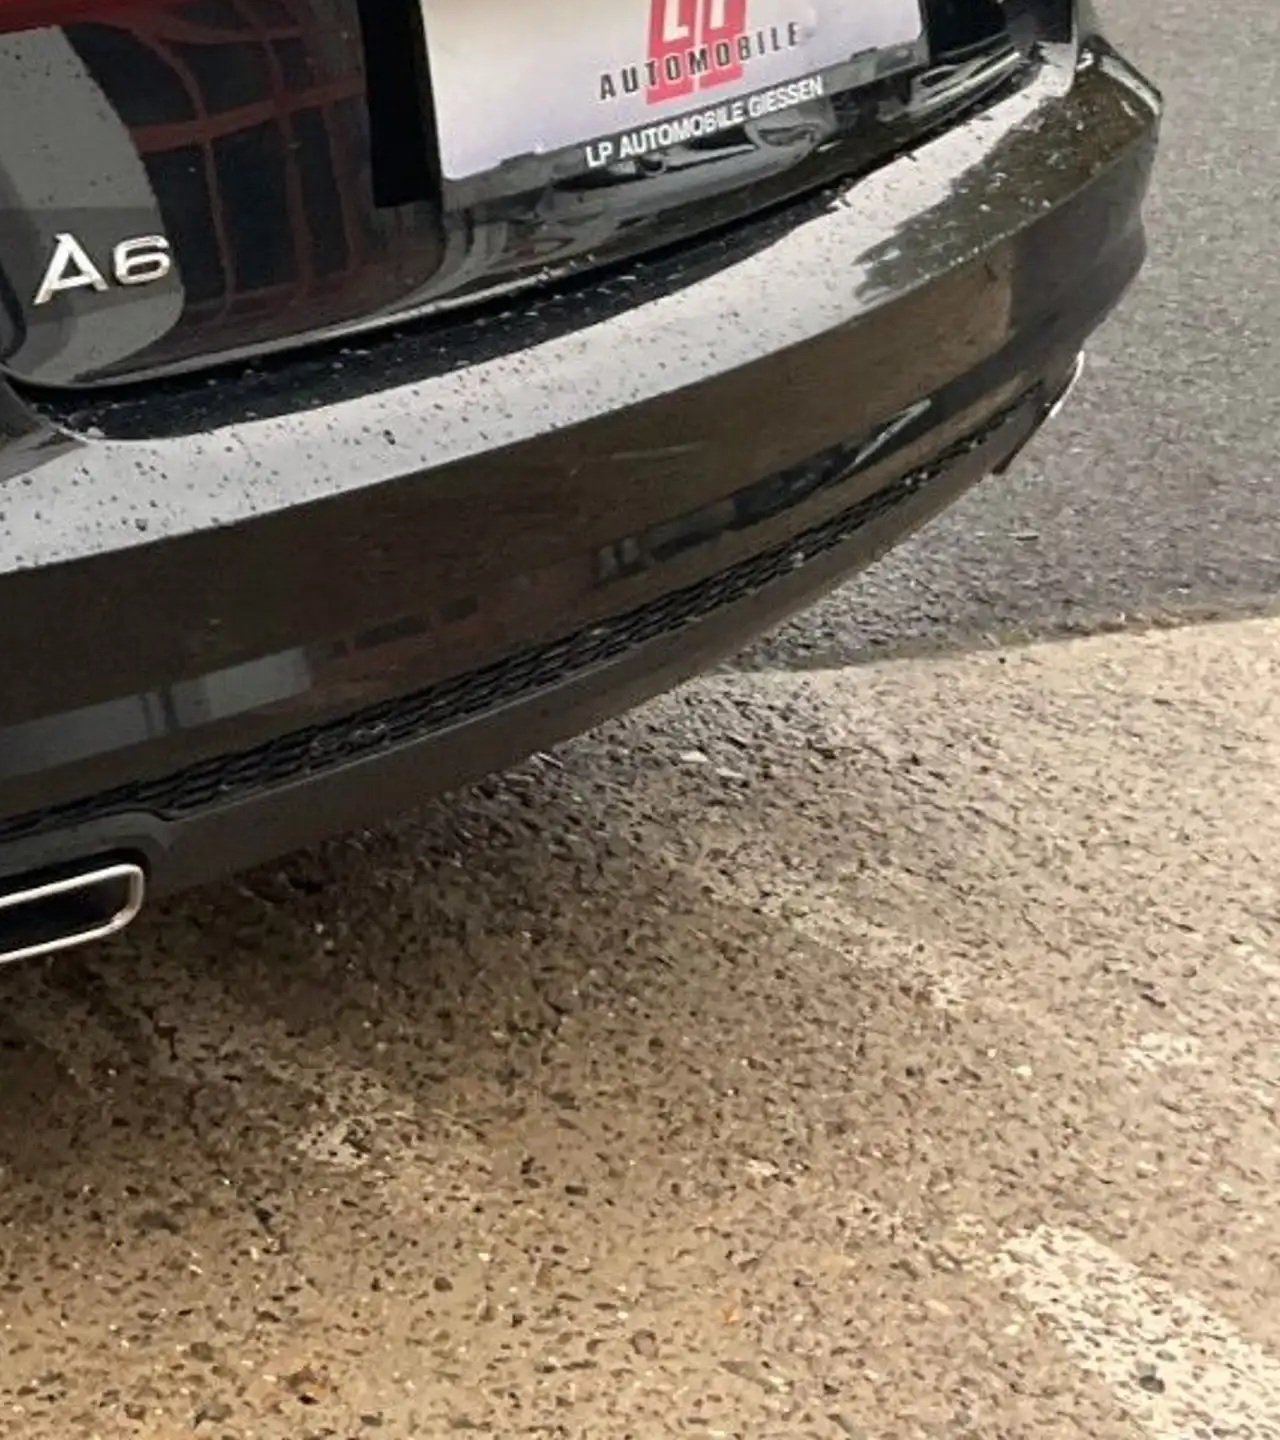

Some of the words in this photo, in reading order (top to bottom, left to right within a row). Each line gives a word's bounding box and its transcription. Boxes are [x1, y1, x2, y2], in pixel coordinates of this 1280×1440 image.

[598, 20, 802, 101] AUTOMOBILE
[586, 139, 614, 168] LP
[619, 101, 744, 160] AUTOMOBILE
[748, 74, 824, 119] GIESSEN
[32, 232, 172, 306] A6
